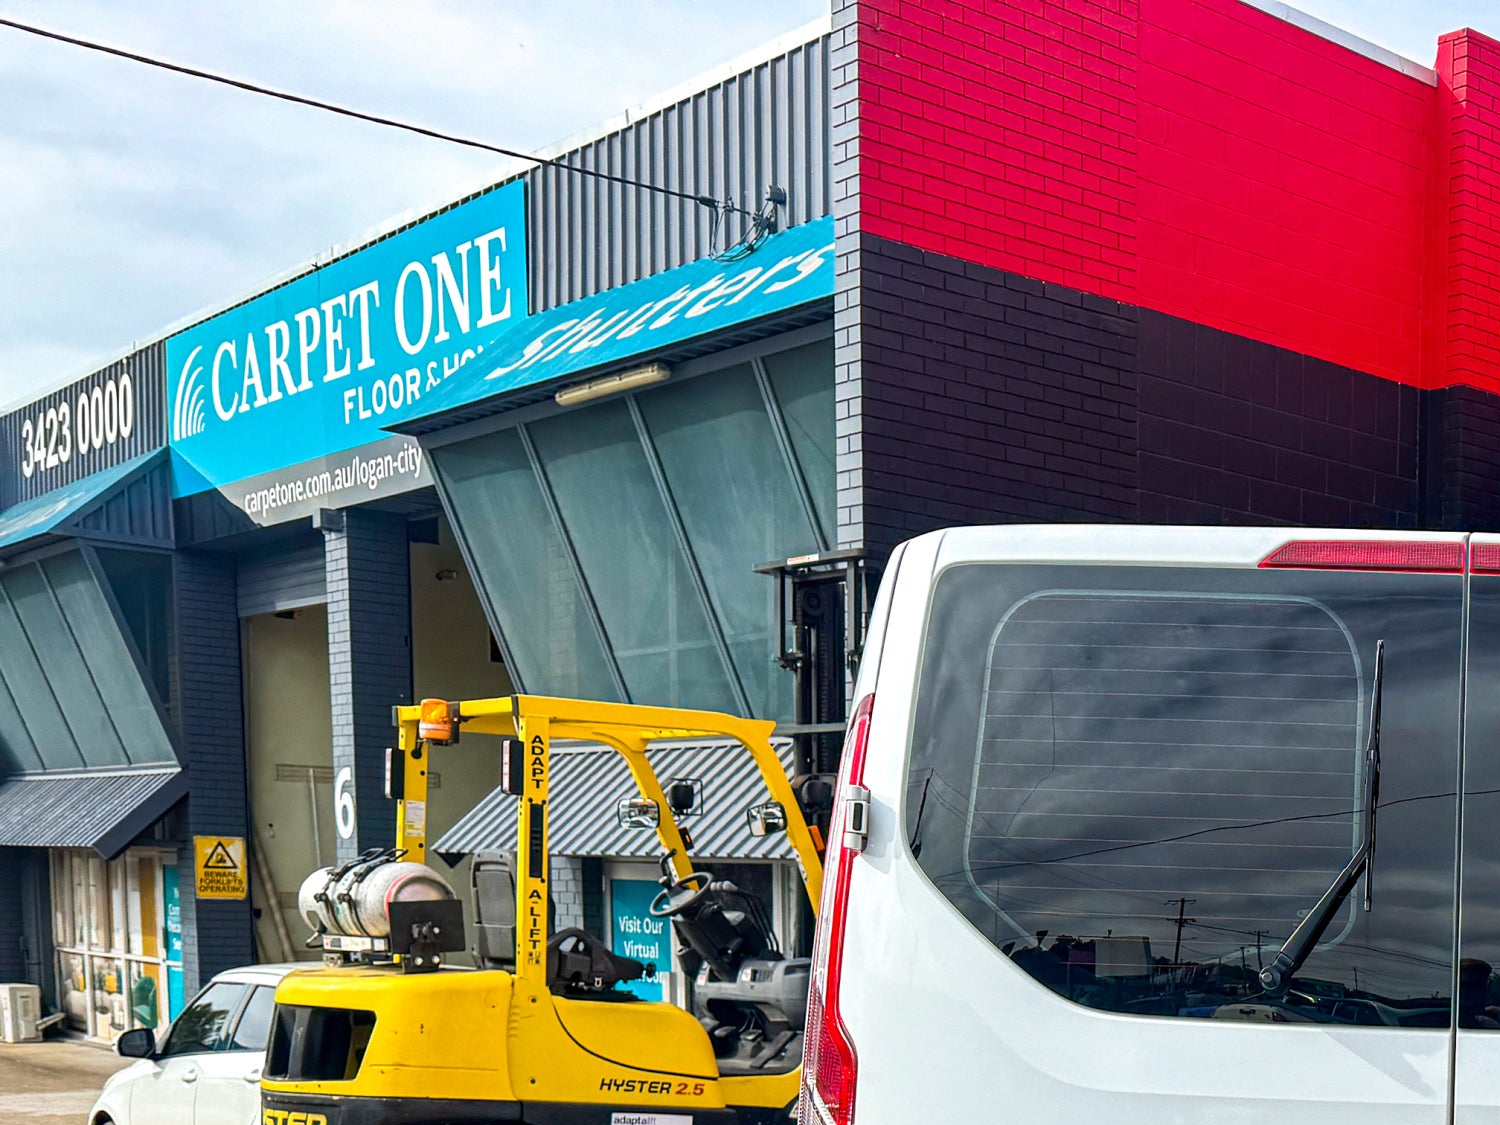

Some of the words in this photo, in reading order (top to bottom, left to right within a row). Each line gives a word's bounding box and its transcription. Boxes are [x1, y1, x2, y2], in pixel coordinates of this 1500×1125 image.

[212, 280, 380, 423] CARPET
[394, 226, 511, 356] ONE
[484, 243, 835, 380] Shutters
[343, 367, 421, 425] FLOOR
[425, 361, 441, 392] &
[21, 407, 72, 478] 3423
[76, 374, 133, 455] 0000
[244, 442, 422, 517] carpetone.com.au/logan-city
[531, 735, 544, 789] ADAPT
[334, 766, 355, 840] 6
[199, 885, 245, 893] OPERATING
[619, 916, 642, 933] Visit
[643, 918, 663, 934] Our
[624, 940, 659, 959] Virtual
[600, 1078, 672, 1094] HYSTER
[675, 1083, 705, 1096] 2.5
